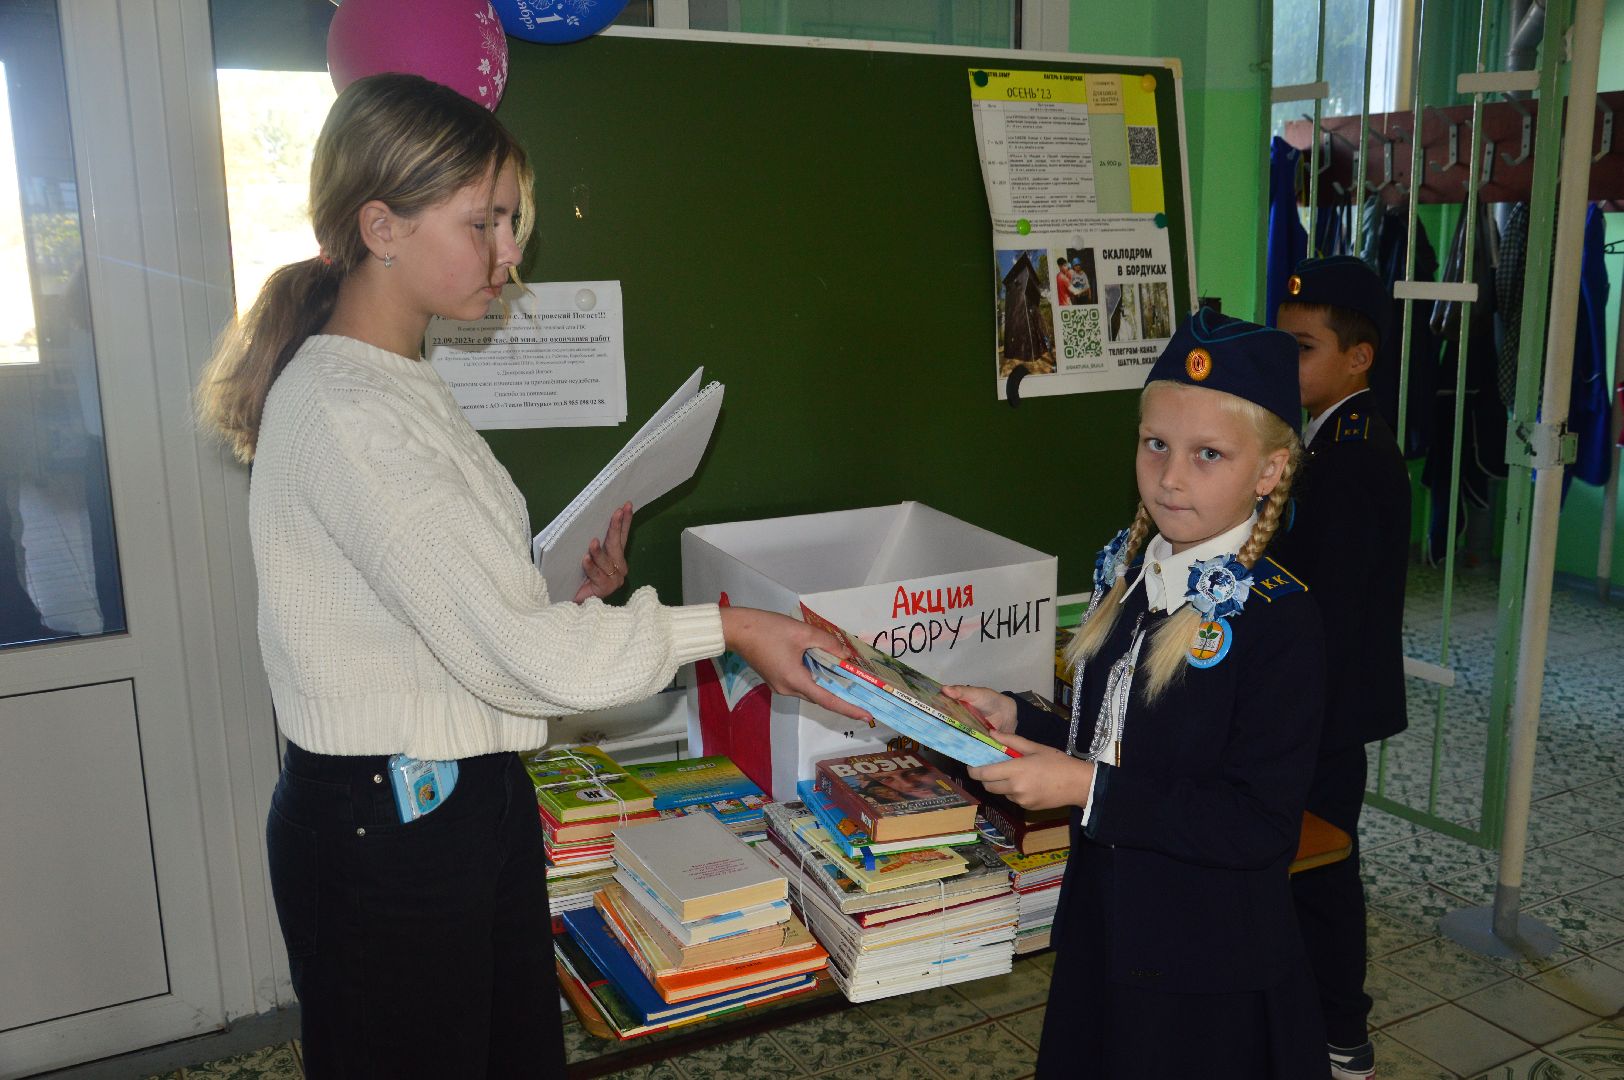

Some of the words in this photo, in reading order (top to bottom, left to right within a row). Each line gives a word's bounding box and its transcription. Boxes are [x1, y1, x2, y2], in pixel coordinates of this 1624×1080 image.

[535, 13, 564, 24] 1
[1102, 248, 1153, 261] СКАЛОДРОМ
[1117, 265, 1124, 276] В
[1126, 264, 1167, 277] БОРДУКАХ
[590, 334, 611, 343] работ
[1260, 573, 1290, 590] КК
[891, 584, 975, 618] Акция
[872, 615, 964, 658] СБОРУ
[980, 598, 1051, 643] КНИГ
